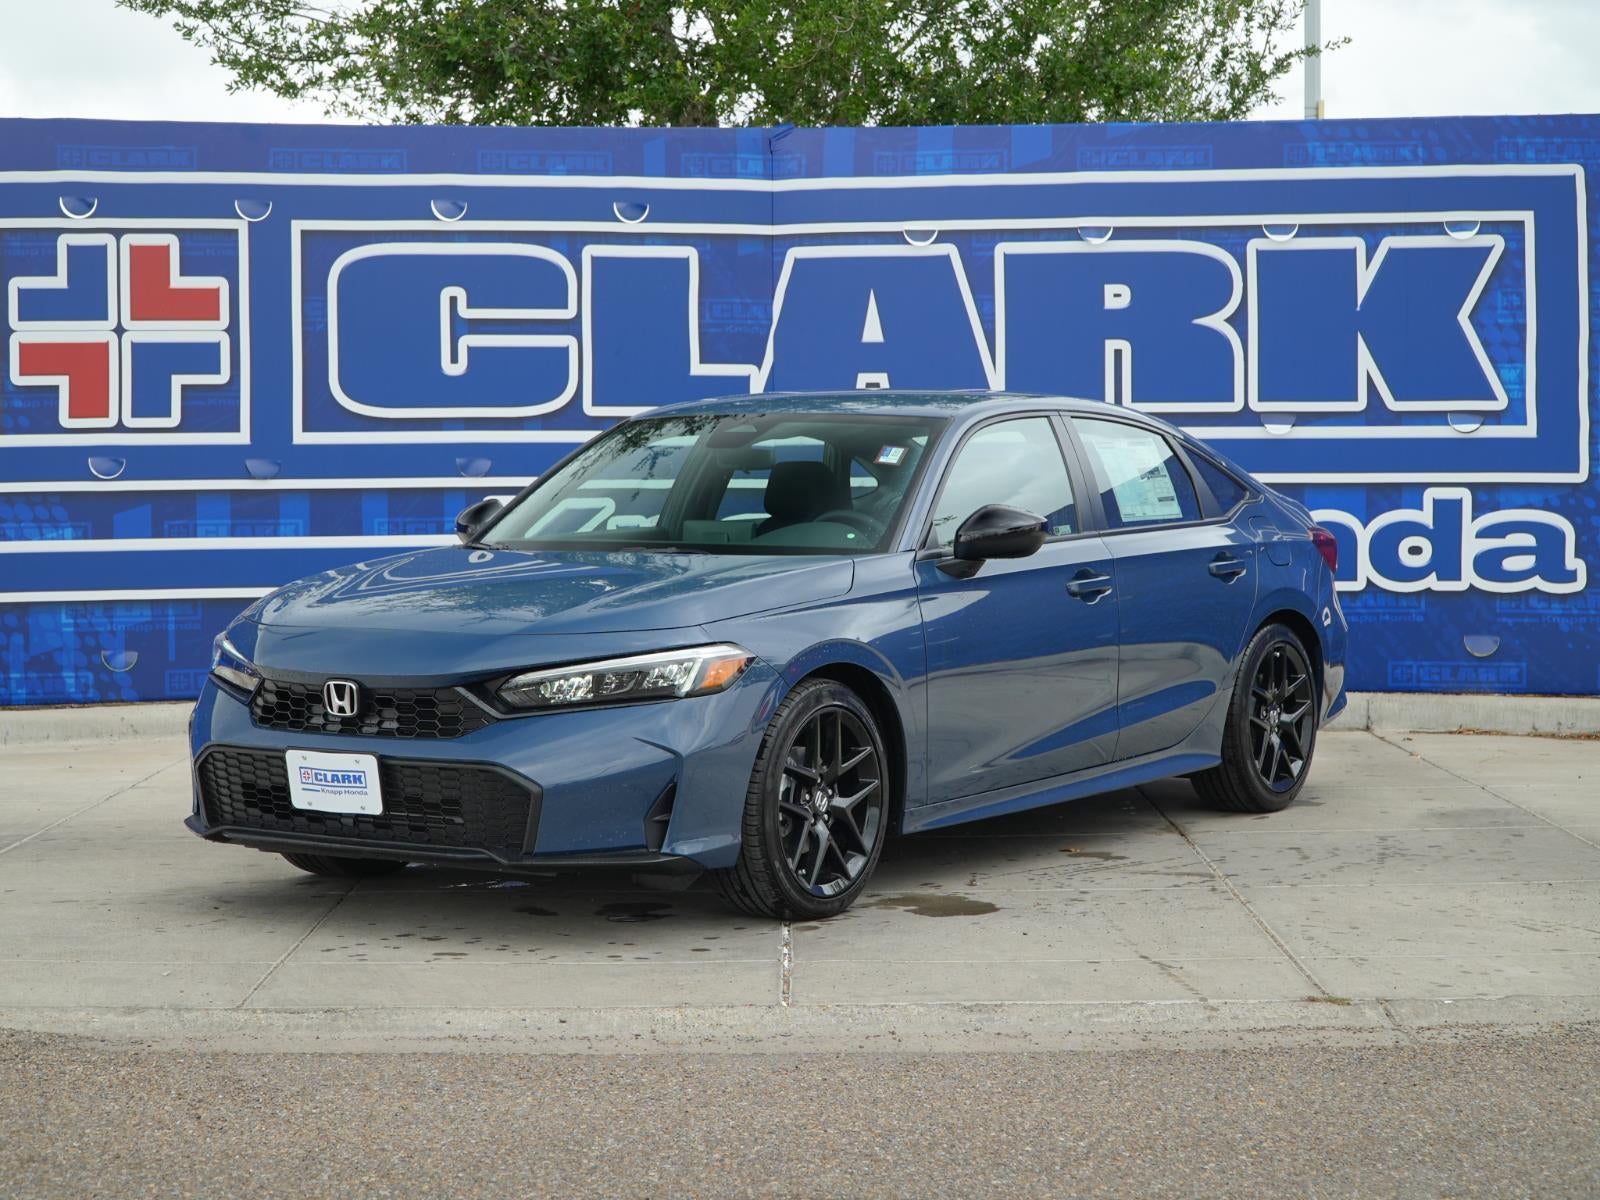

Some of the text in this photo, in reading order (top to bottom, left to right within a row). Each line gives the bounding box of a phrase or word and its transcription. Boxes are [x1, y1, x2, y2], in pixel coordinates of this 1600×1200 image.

[88, 150, 194, 170] CLARK
[1107, 149, 1207, 166] CLARK
[327, 235, 1507, 419] CLARK
[1311, 486, 1587, 594] nda
[1419, 665, 1520, 683] CLARK
[314, 772, 364, 785] CLARK
[320, 787, 368, 796] Knapp Honda
